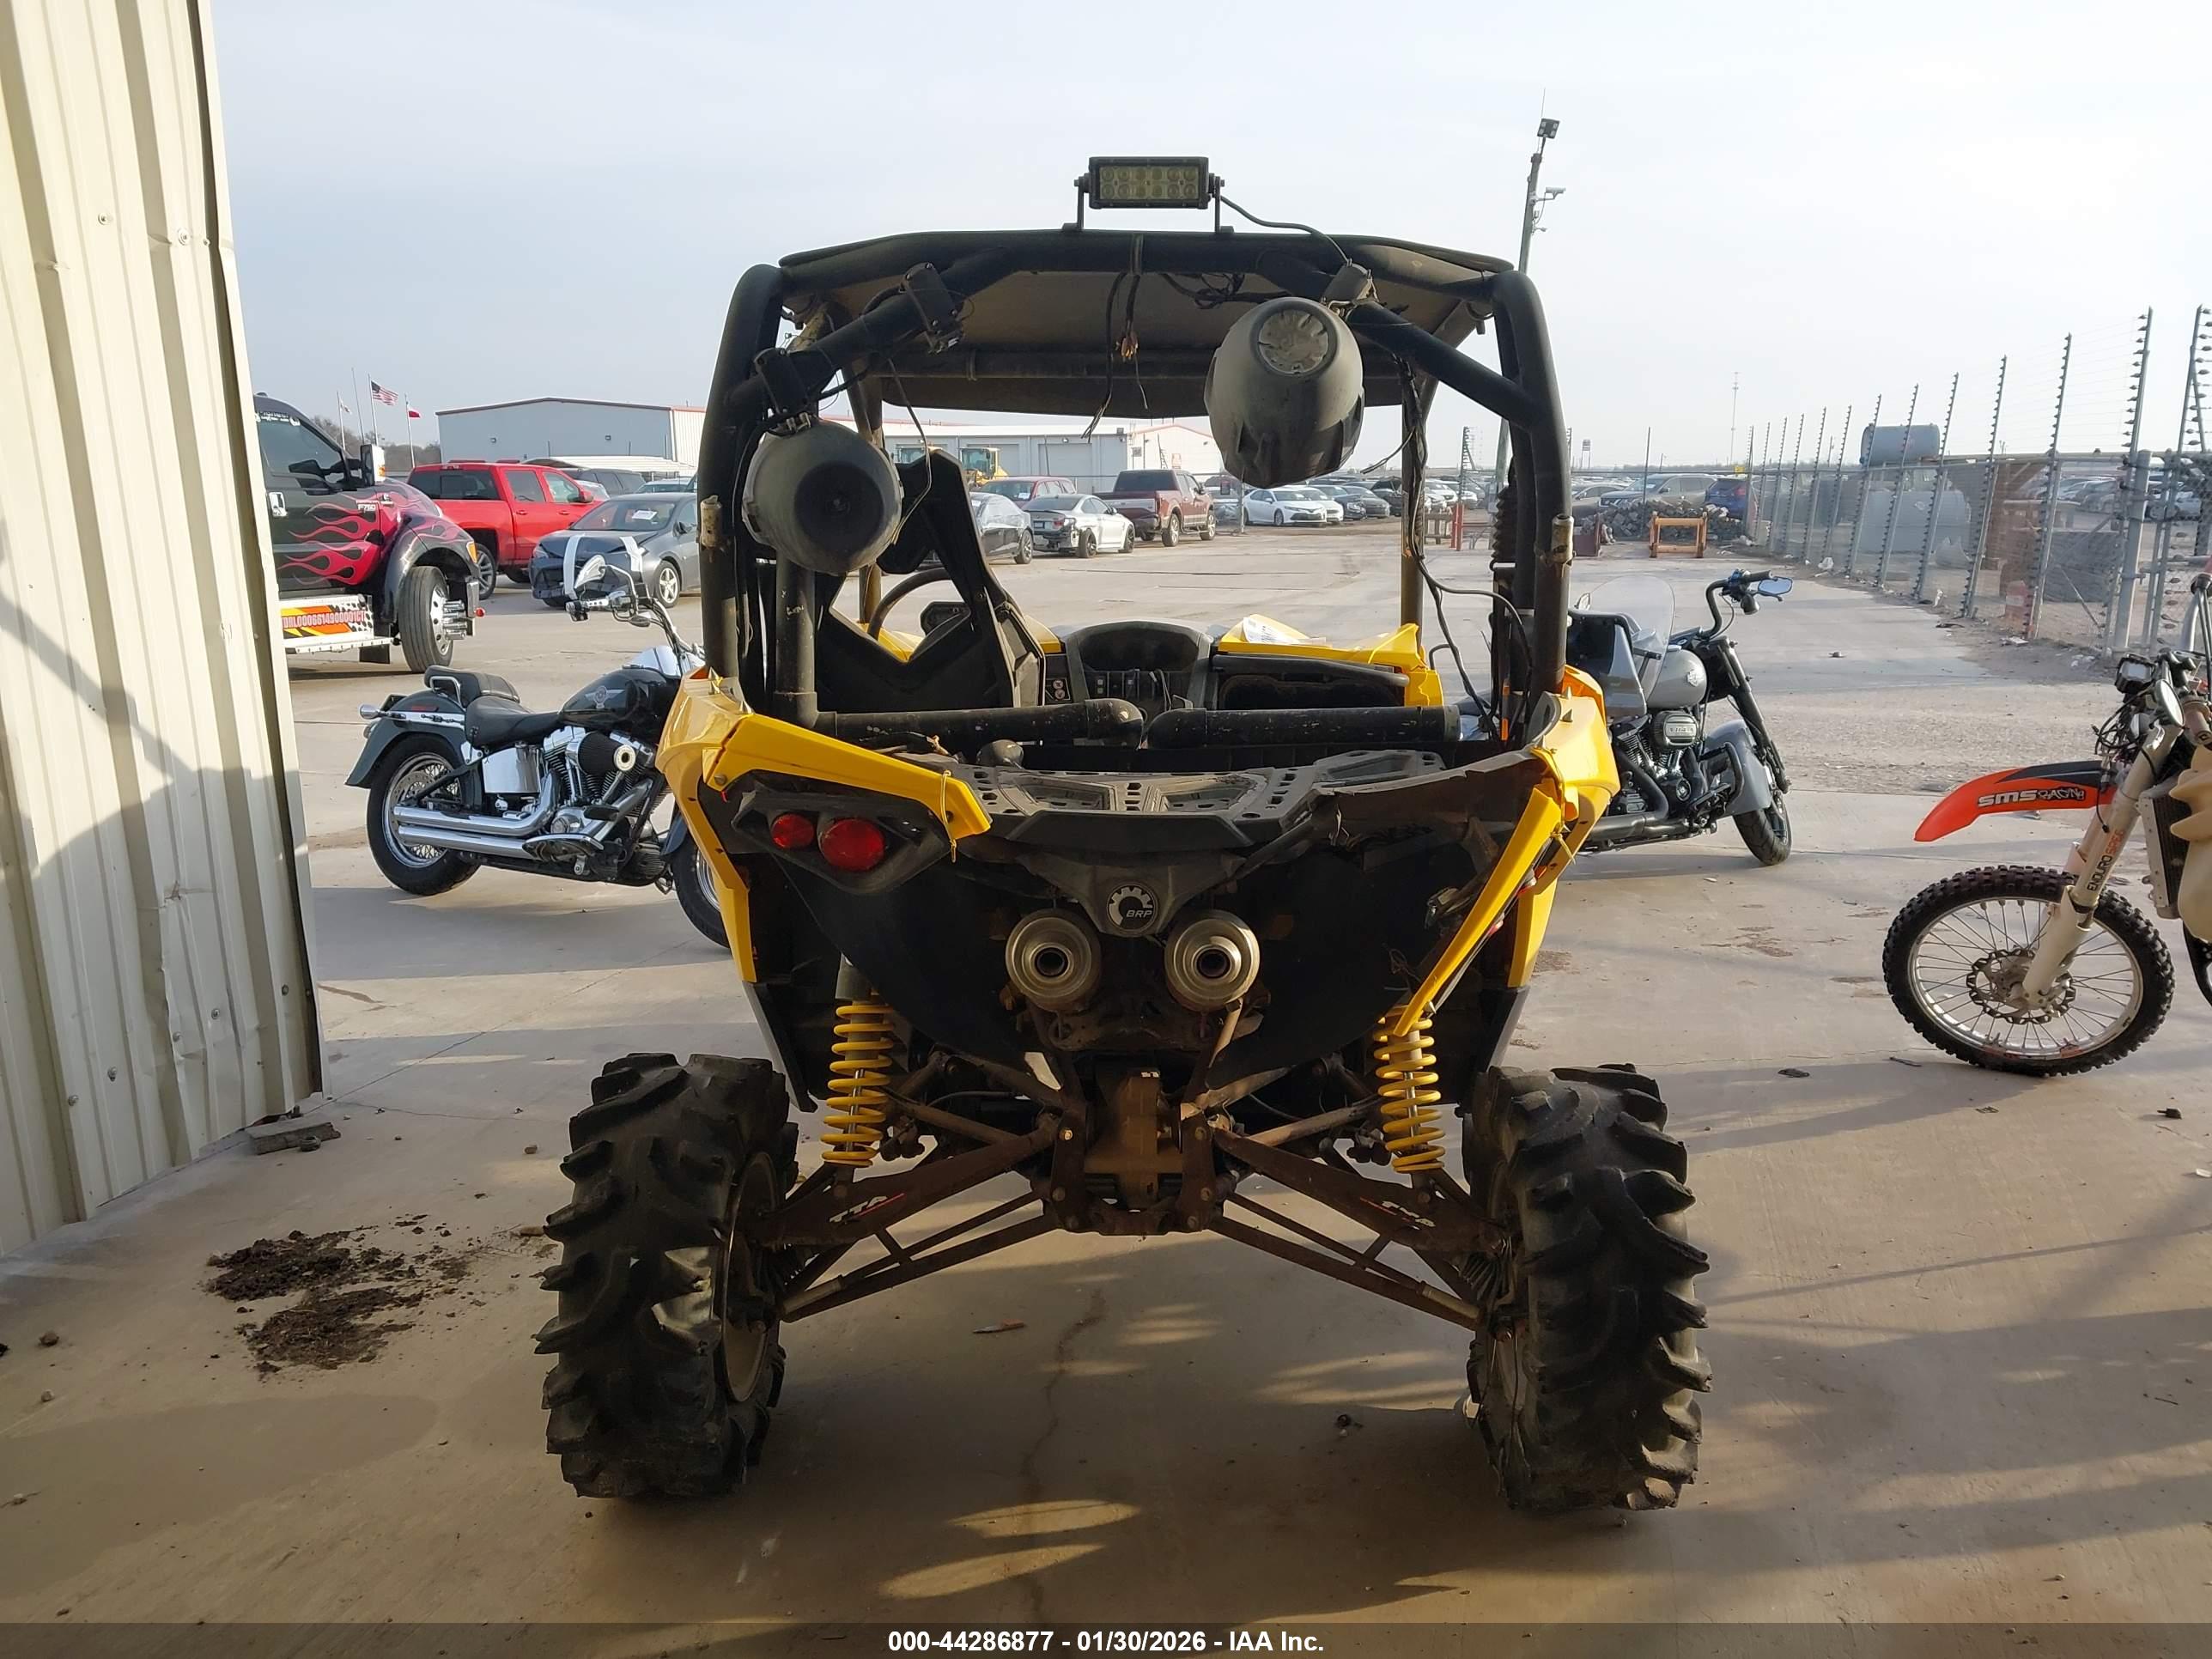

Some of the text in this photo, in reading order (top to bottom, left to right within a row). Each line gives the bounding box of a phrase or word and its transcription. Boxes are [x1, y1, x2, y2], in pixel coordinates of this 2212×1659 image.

[1978, 789, 2037, 807] SMS
[2087, 854, 2113, 891] ENDURO
[1126, 909, 1152, 918] BRP
